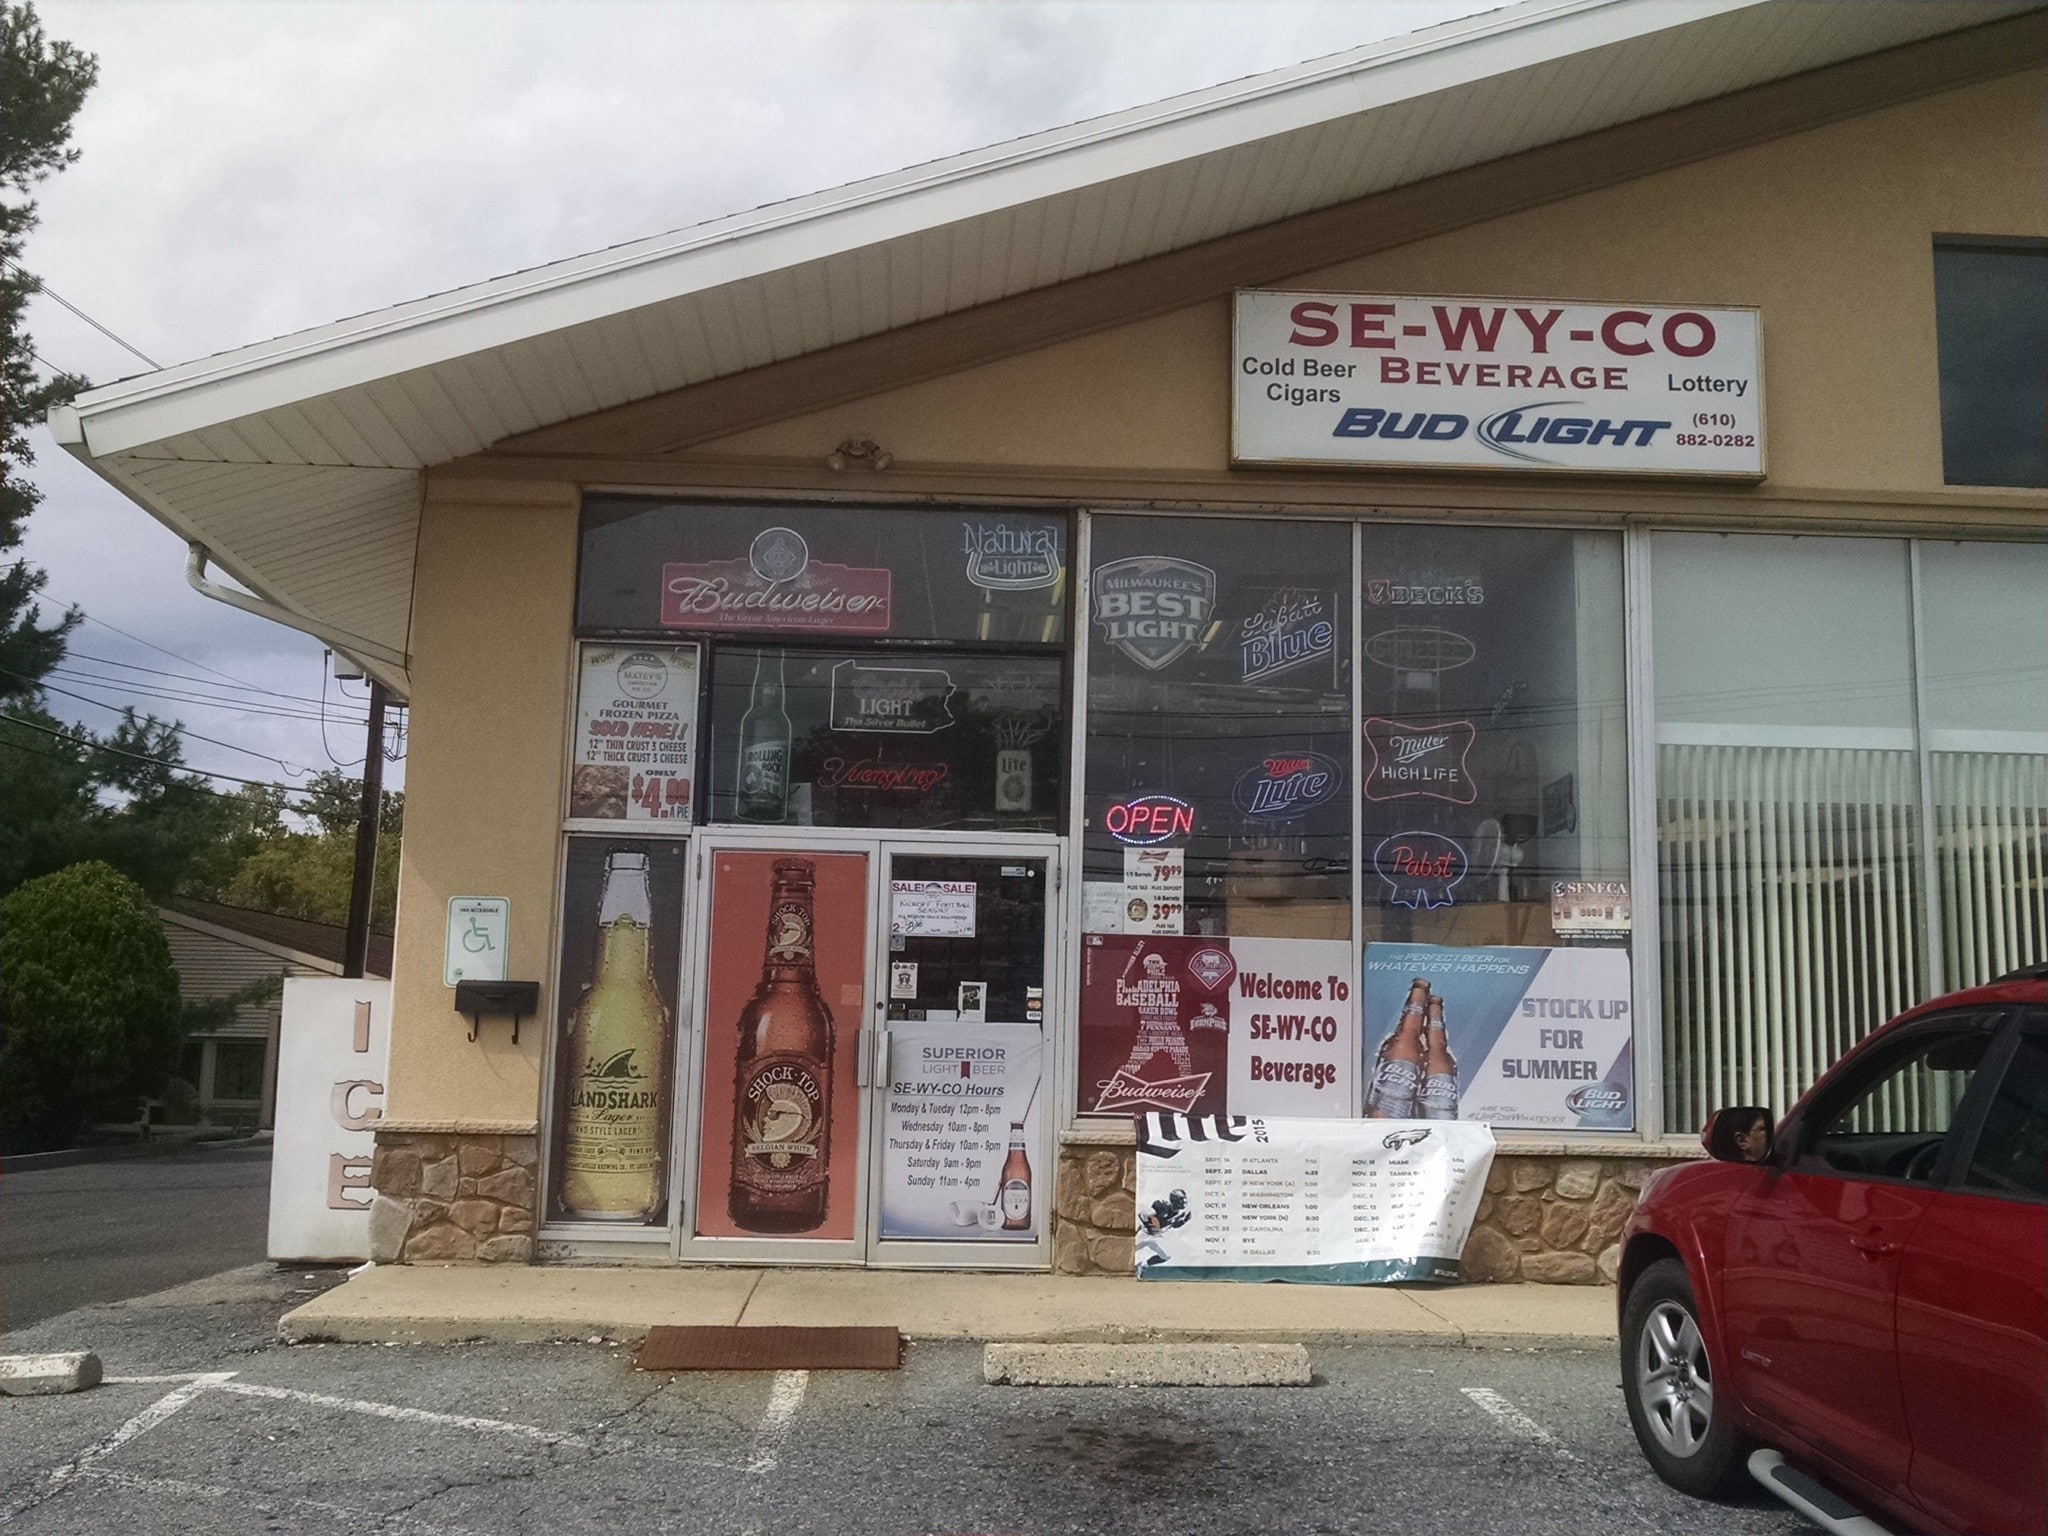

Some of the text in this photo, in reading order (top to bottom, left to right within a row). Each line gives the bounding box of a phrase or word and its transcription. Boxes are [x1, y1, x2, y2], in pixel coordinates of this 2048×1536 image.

[1289, 302, 1716, 357] SE-WY-CO
[1243, 358, 1356, 378] Cold Beer
[1380, 357, 1628, 389] BEVERAGE
[1267, 383, 1340, 405] Cigars
[1668, 374, 1748, 397] Lottery
[1332, 408, 1671, 446] BUD LIGHT
[1692, 412, 1736, 429] (610)
[1676, 433, 1755, 449] 882-0282
[963, 523, 1058, 554] Natural
[994, 559, 1032, 577] Light
[1106, 578, 1201, 591] MILWAUKEE'S
[1391, 580, 1484, 604] BECK'S
[669, 577, 886, 614] Budweiser
[1101, 592, 1208, 619] BEST
[1242, 596, 1322, 637] Labatt
[1110, 620, 1198, 641] LIGHT
[1241, 621, 1332, 674] Blue
[613, 700, 668, 710] GOURMET
[860, 699, 913, 716] LIGHT
[600, 710, 679, 720] FROZEN PIZZA
[845, 717, 926, 728] The Silver Bullet
[589, 720, 629, 736] SOLD
[589, 739, 687, 752] 12" THIN CRUST 3 CHEESE
[1390, 736, 1449, 761] Miller
[586, 751, 688, 764] 12" THICK CRUST 3 CHEESE
[1003, 758, 1027, 773] Lite
[818, 757, 947, 791] Yuengling
[1382, 766, 1458, 782] HIGH LIFE
[1249, 773, 1328, 813] Lite
[670, 806, 688, 818] A PIE
[1107, 805, 1194, 833] OPEN
[1392, 846, 1456, 877] Pabst
[893, 883, 975, 893] SALE! SALE!
[1567, 882, 1627, 894] SENECA
[893, 923, 900, 932] 2
[1405, 953, 1459, 961] PERFECT
[1369, 962, 1530, 974] WHATEVER HAPPENS
[1239, 972, 1349, 1001] Welcome To
[1117, 993, 1179, 1007] BASEBALL
[1522, 998, 1629, 1020] STOCK UP
[1250, 1014, 1337, 1042] SE-WY-CO
[1540, 1029, 1584, 1050] FOR
[922, 1047, 1006, 1060] SUPERIOR
[922, 1064, 1006, 1075] LIGHT BEER
[1251, 1056, 1336, 1089] Beverage
[1384, 1063, 1417, 1080] BUD
[1502, 1059, 1598, 1081] SUMMER
[749, 1066, 819, 1102] SHOCK TOP
[893, 1082, 1004, 1095] SE-WY-CO Hours
[1097, 1080, 1206, 1099] Budweiser
[1426, 1079, 1456, 1091] BUD
[571, 1090, 658, 1109] LANDSHARK
[1583, 1090, 1621, 1100] BUD
[890, 1102, 1001, 1116] Monday & Tueday 12pm 8pm
[1576, 1099, 1625, 1109] LIGHT
[592, 1109, 634, 1126] Lager
[590, 1126, 612, 1135] STYLE
[614, 1127, 637, 1135] LAGER
[901, 1120, 989, 1134] Wednesday 10am 8pm
[1252, 1119, 1269, 1143] 2015
[889, 1138, 1001, 1152] Thursday & Friday 10am 9pm
[907, 1156, 981, 1170] Saturday 9am 9pm
[907, 1175, 980, 1188] Sunday 11am 4pm
